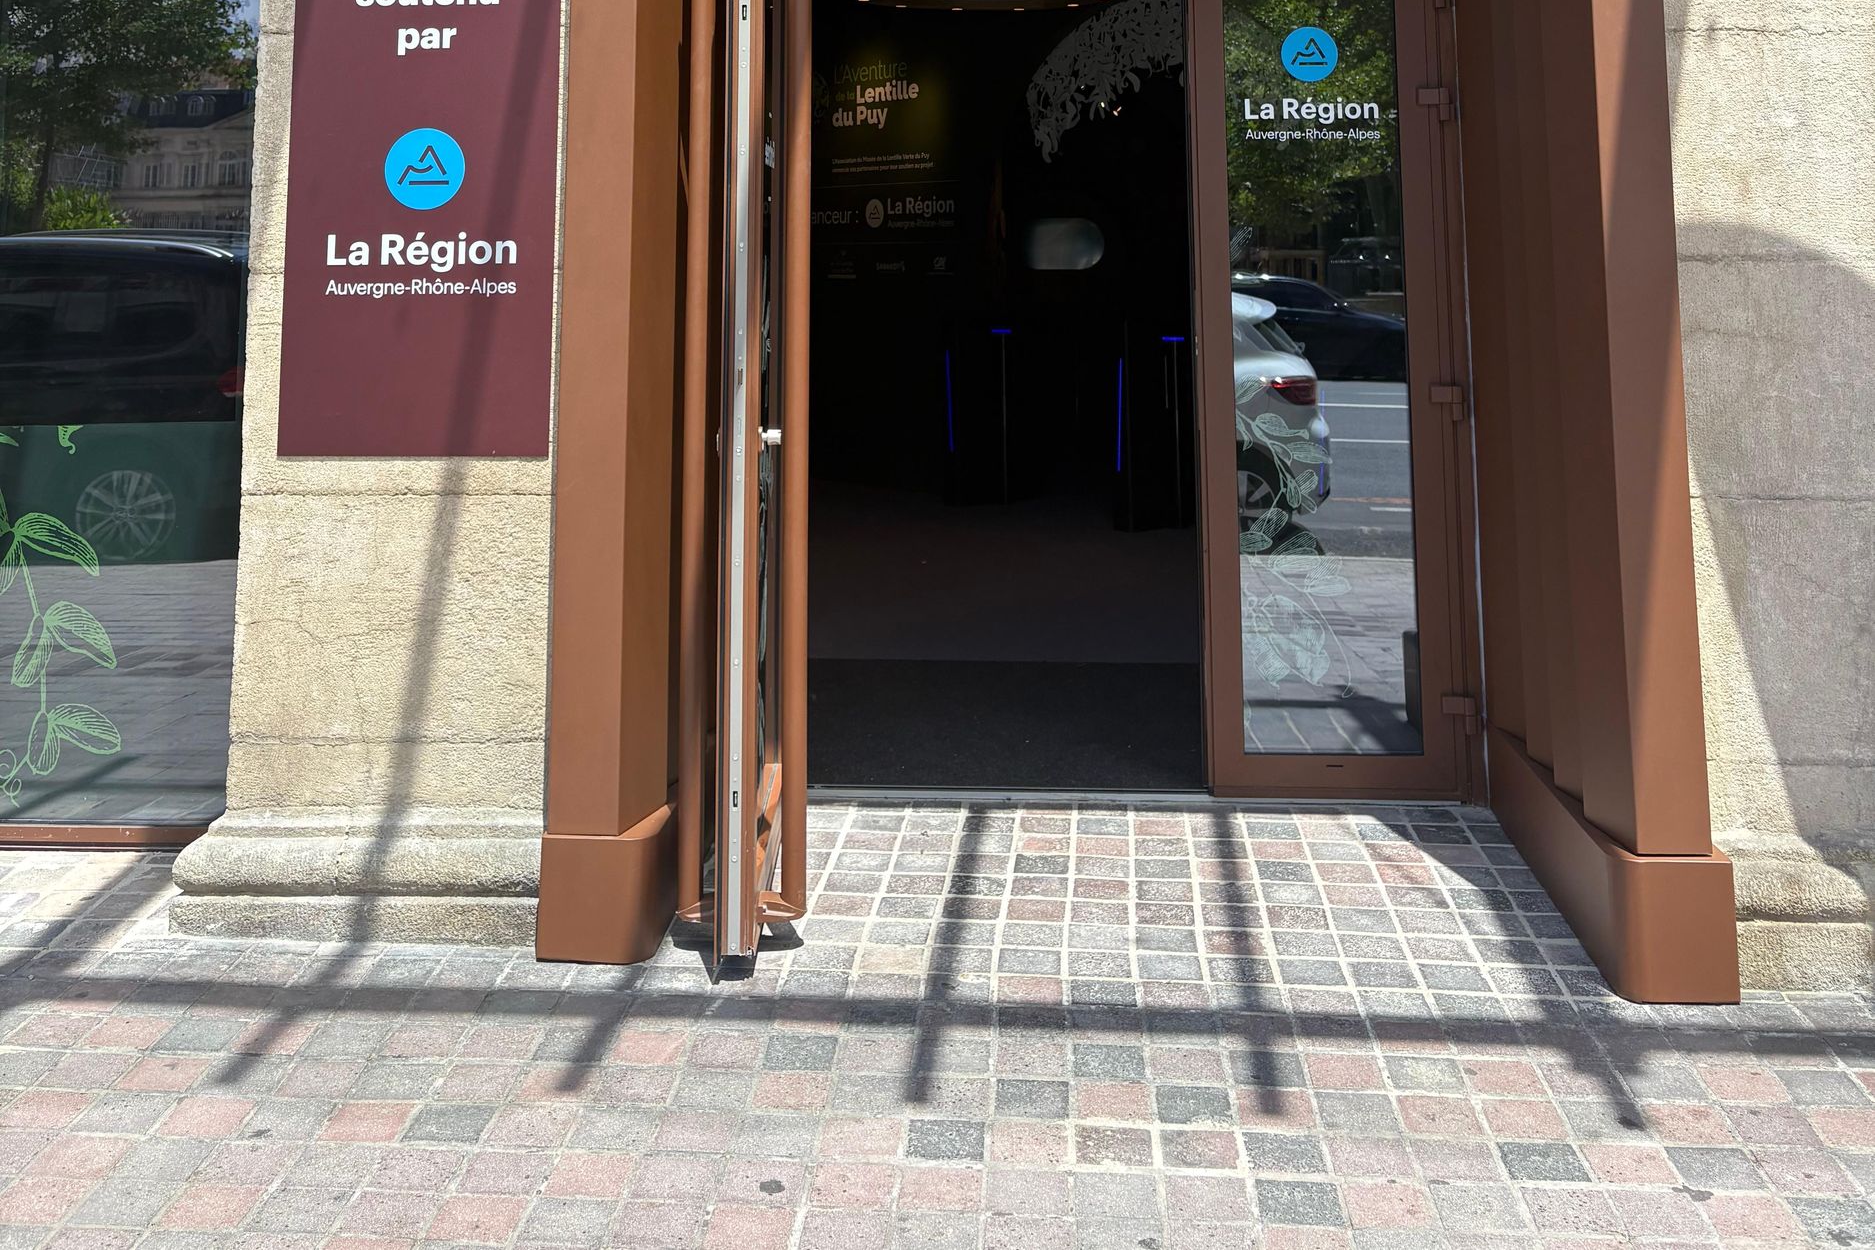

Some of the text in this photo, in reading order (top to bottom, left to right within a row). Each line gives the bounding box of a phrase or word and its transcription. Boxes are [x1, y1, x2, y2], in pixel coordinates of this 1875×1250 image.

[397, 27, 457, 56] par
[856, 80, 919, 104] Lentille
[832, 106, 888, 130] du Puy
[1244, 97, 1379, 125] La Région
[1245, 128, 1381, 142] Auvergne-Rhône-Alpes
[811, 210, 852, 225] anceur
[887, 196, 956, 218] La Région
[326, 231, 518, 273] La Région
[325, 277, 517, 299] Auvergne-Rhône-Alpes
